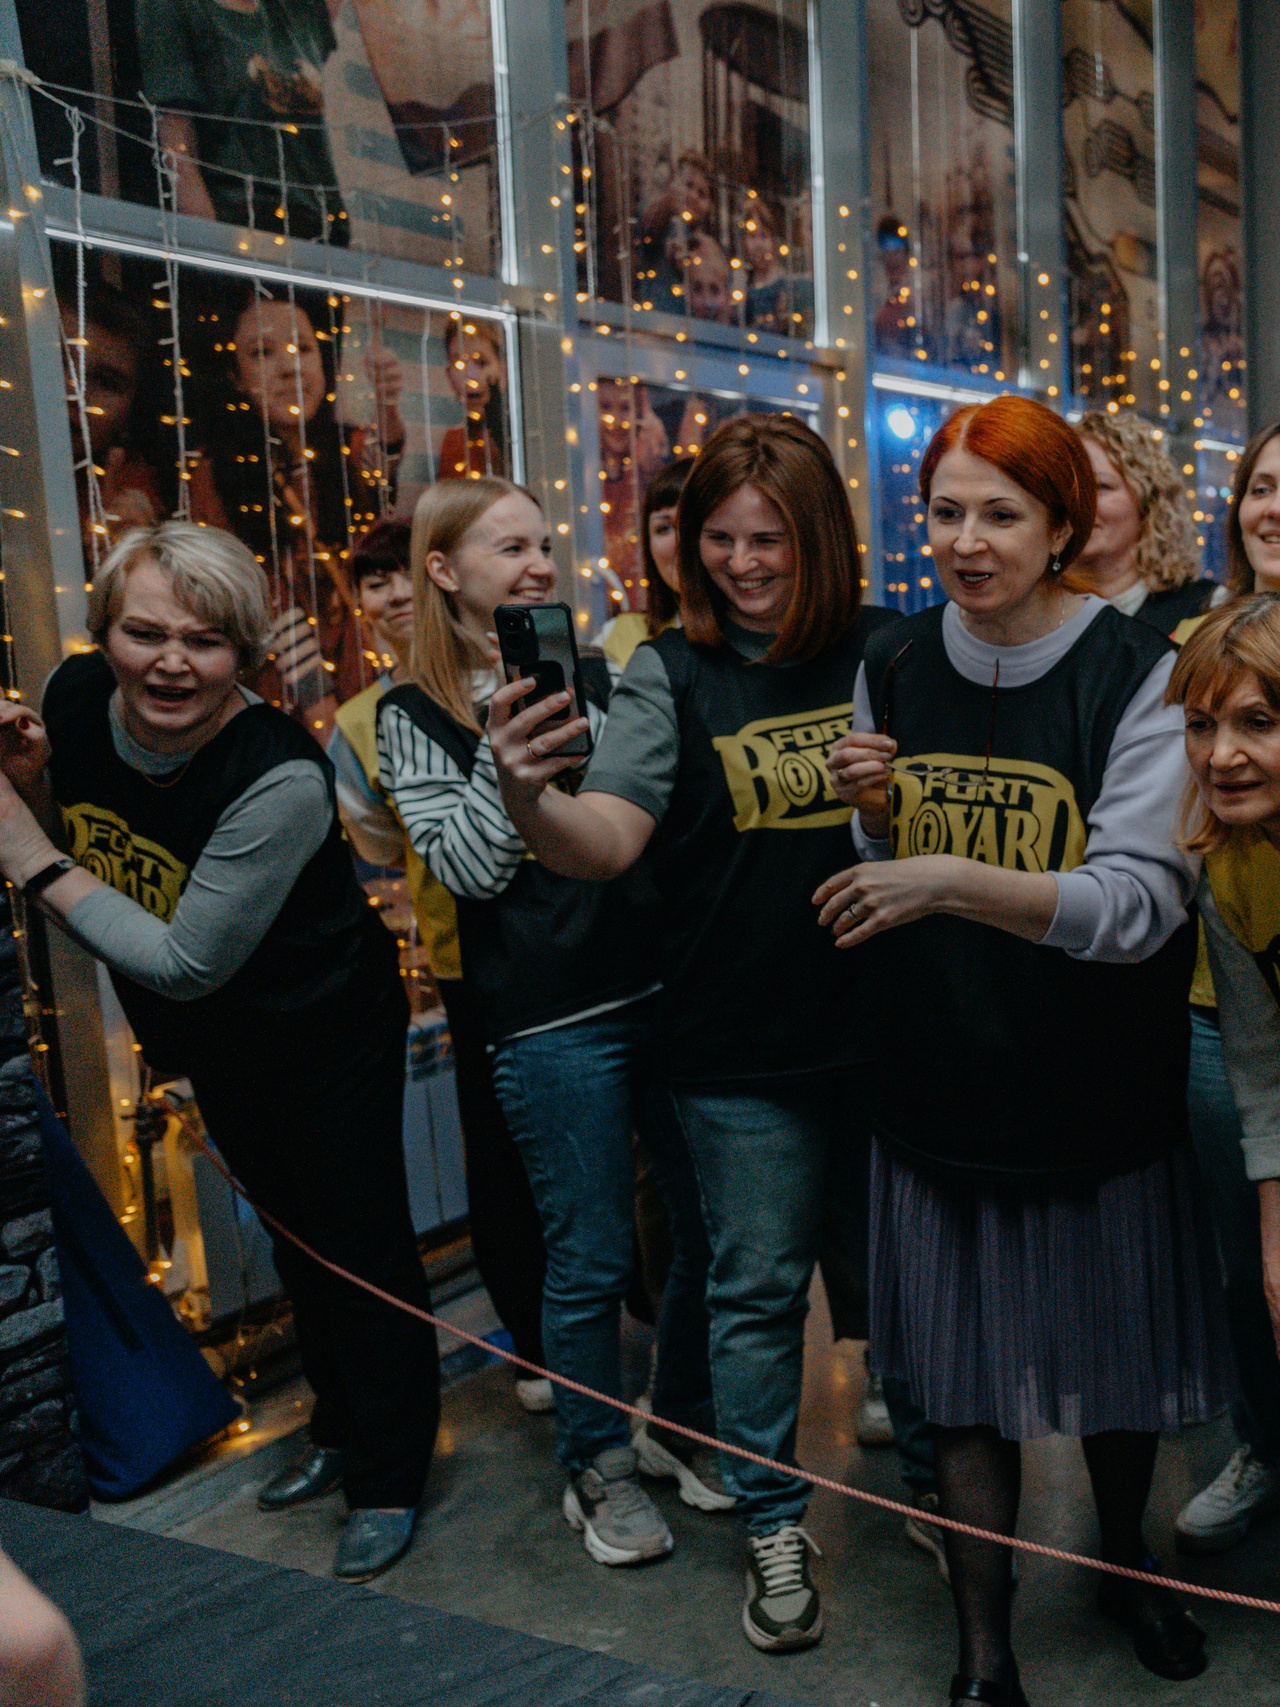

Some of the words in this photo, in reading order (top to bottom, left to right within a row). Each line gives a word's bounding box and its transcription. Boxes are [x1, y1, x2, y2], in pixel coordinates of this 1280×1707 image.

[770, 716, 853, 750] FOR
[711, 734, 839, 832] BOY
[923, 770, 1029, 805] FORT
